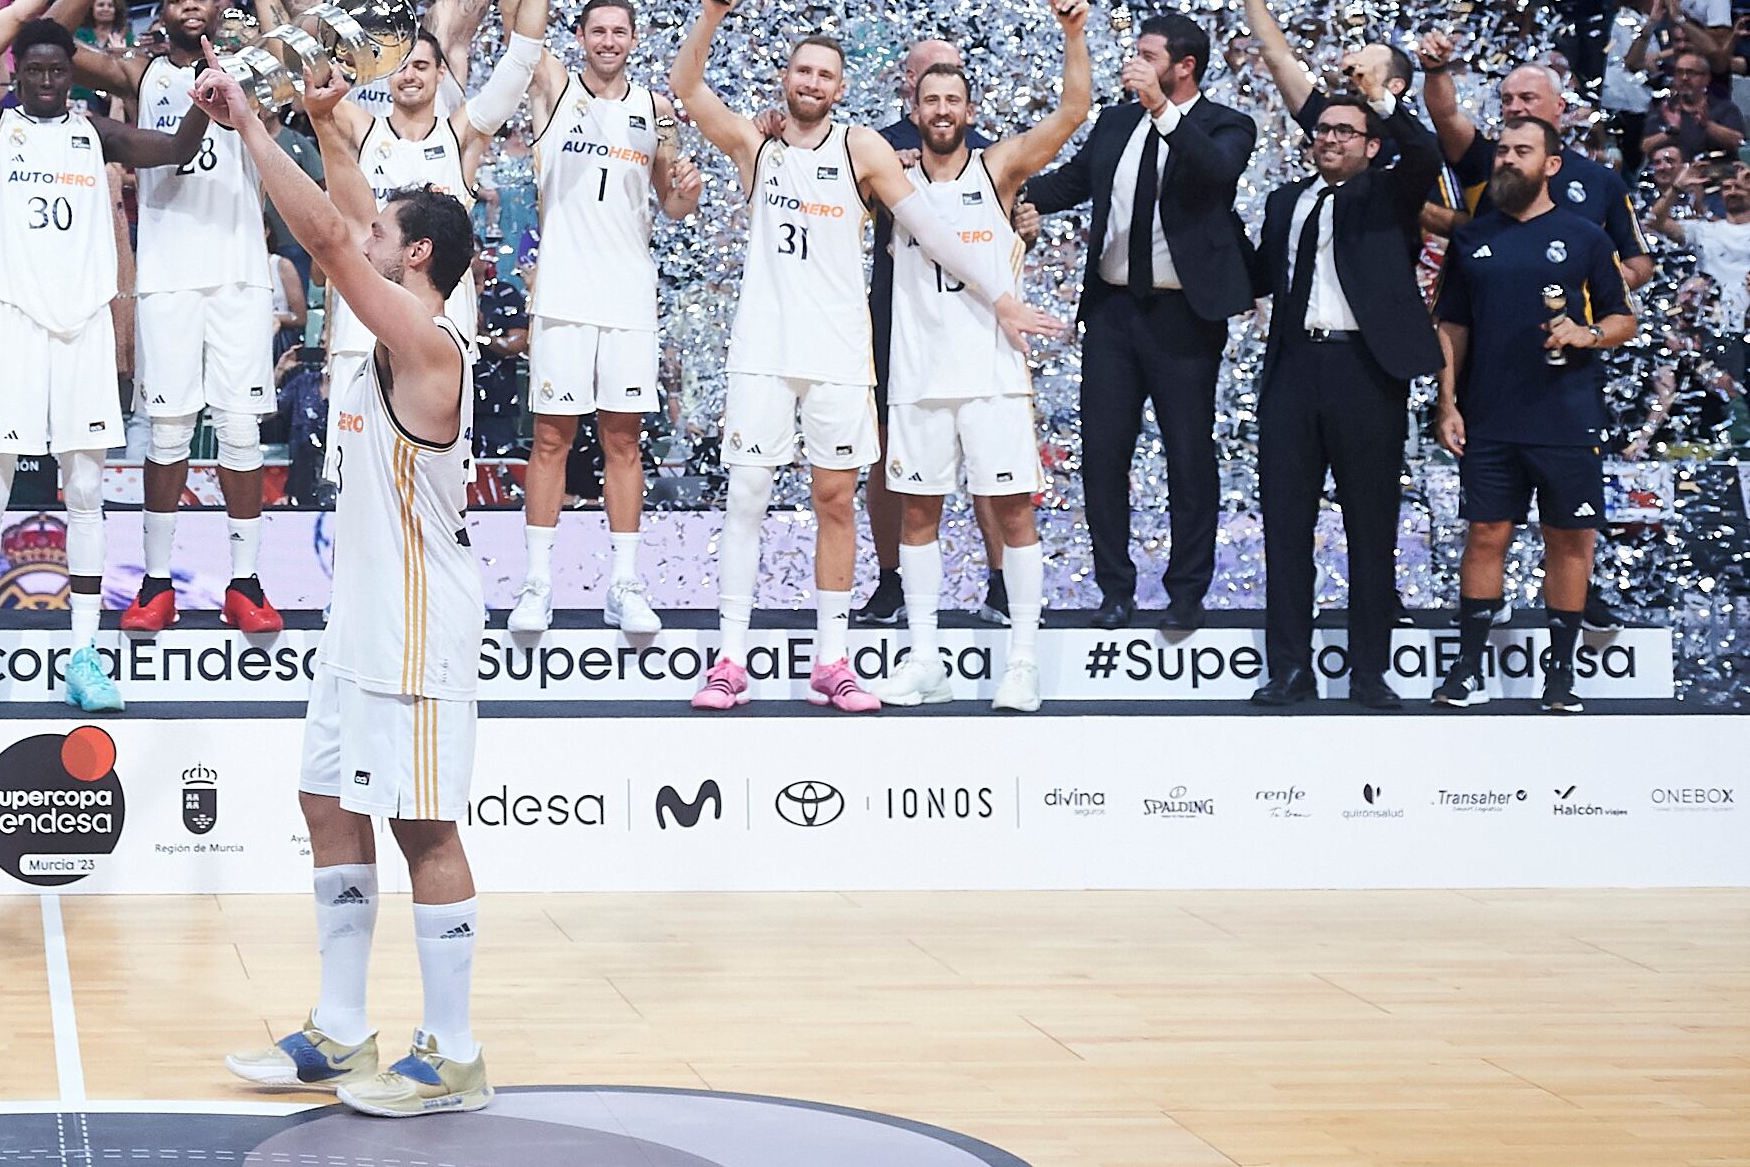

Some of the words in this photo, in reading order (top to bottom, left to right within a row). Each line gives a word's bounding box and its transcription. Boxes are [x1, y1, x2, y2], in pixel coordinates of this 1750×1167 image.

[357, 89, 394, 104] AUTO
[562, 140, 650, 166] AUTOHERO
[8, 170, 97, 187] AUTOHERO
[597, 167, 608, 202] 1
[27, 196, 72, 231] 30
[765, 191, 843, 218] UTOHERO
[778, 222, 809, 261] 31
[887, 787, 993, 819] IONOS
[1044, 788, 1105, 806] divina
[1255, 785, 1306, 805] renfe
[1438, 790, 1512, 805] Transaher
[1651, 788, 1734, 804] ONEBOX
[467, 785, 605, 827] desa
[1143, 798, 1214, 815] SPALDING
[1553, 804, 1603, 816] Halcón
[155, 843, 191, 855] Región
[193, 844, 207, 853] de
[209, 844, 244, 853] Murcia
[29, 858, 74, 870] Murcia
